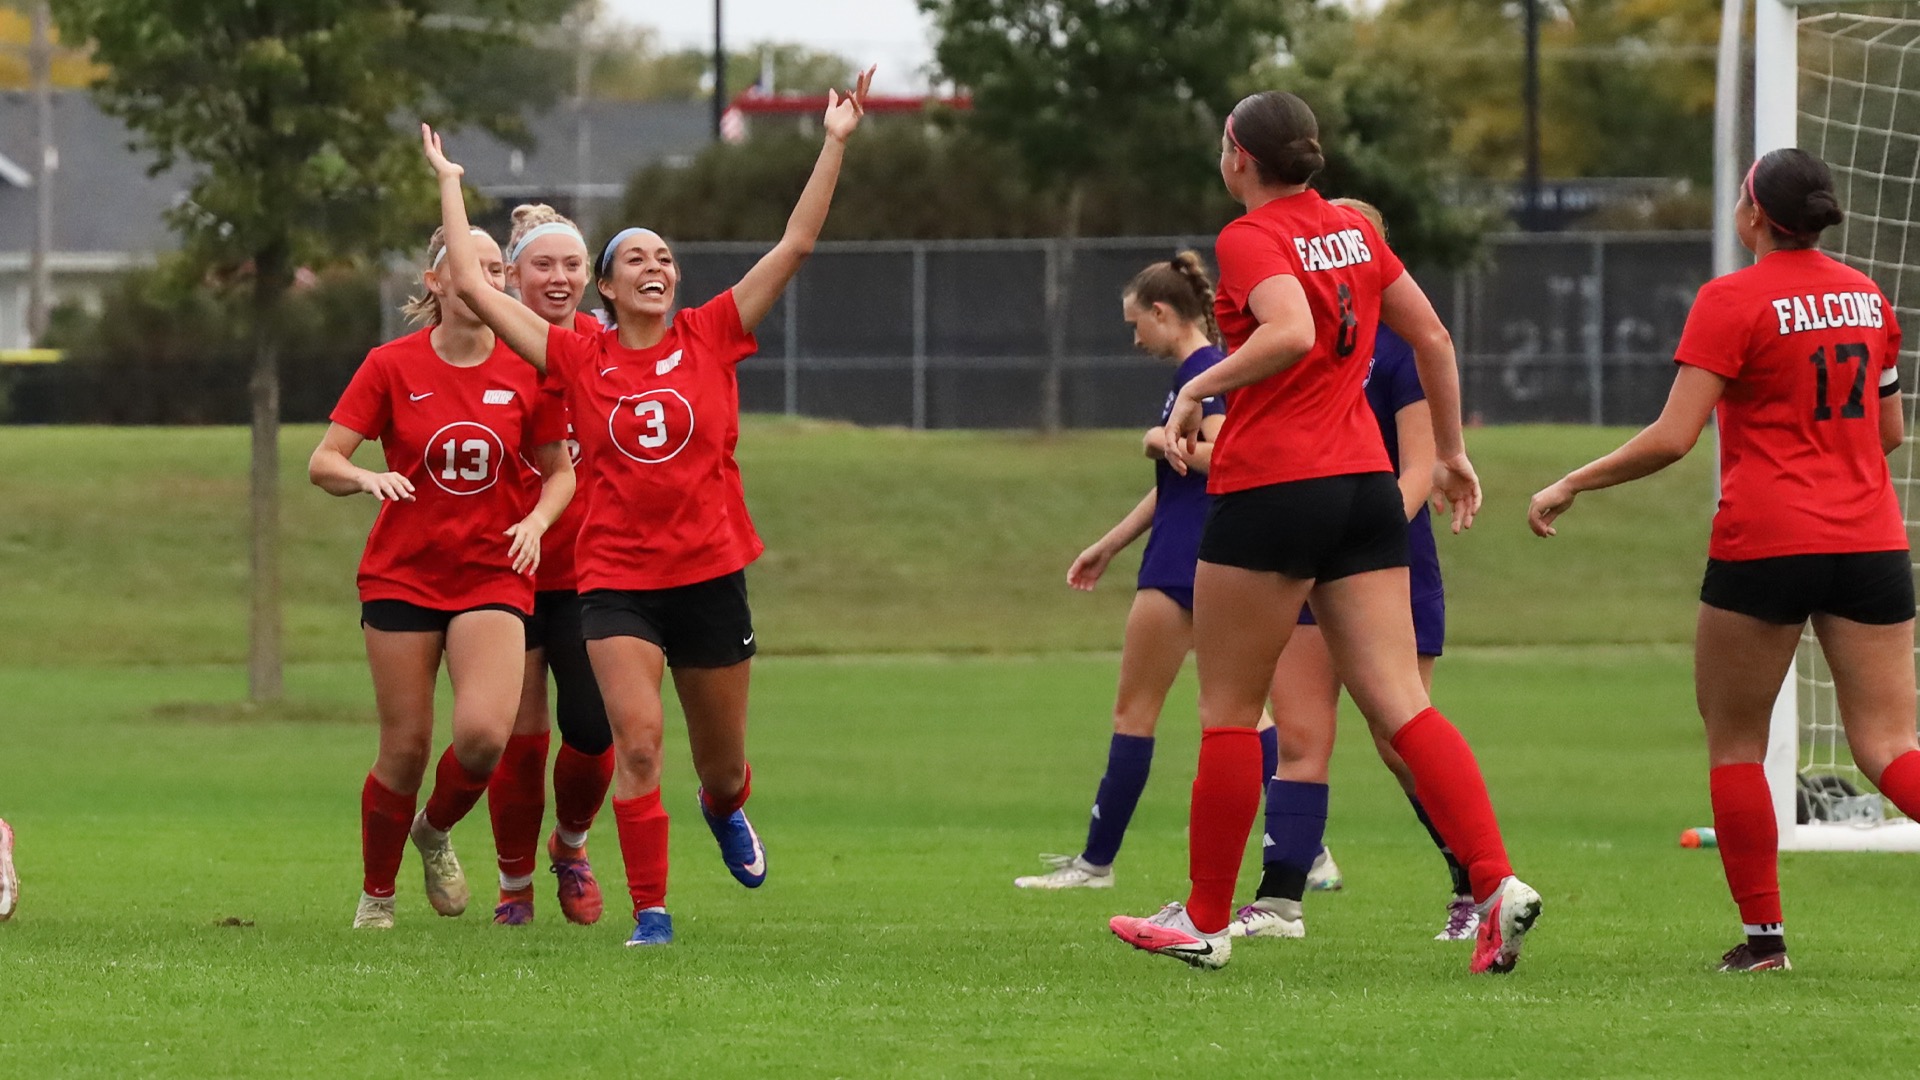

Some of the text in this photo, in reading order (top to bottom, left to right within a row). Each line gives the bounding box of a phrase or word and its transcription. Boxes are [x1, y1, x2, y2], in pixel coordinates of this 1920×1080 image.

[1293, 229, 1371, 271] FALONS
[1772, 292, 1882, 334] FALCONS
[1810, 343, 1869, 420] 17
[634, 400, 667, 448] 3
[442, 439, 489, 481] 13
